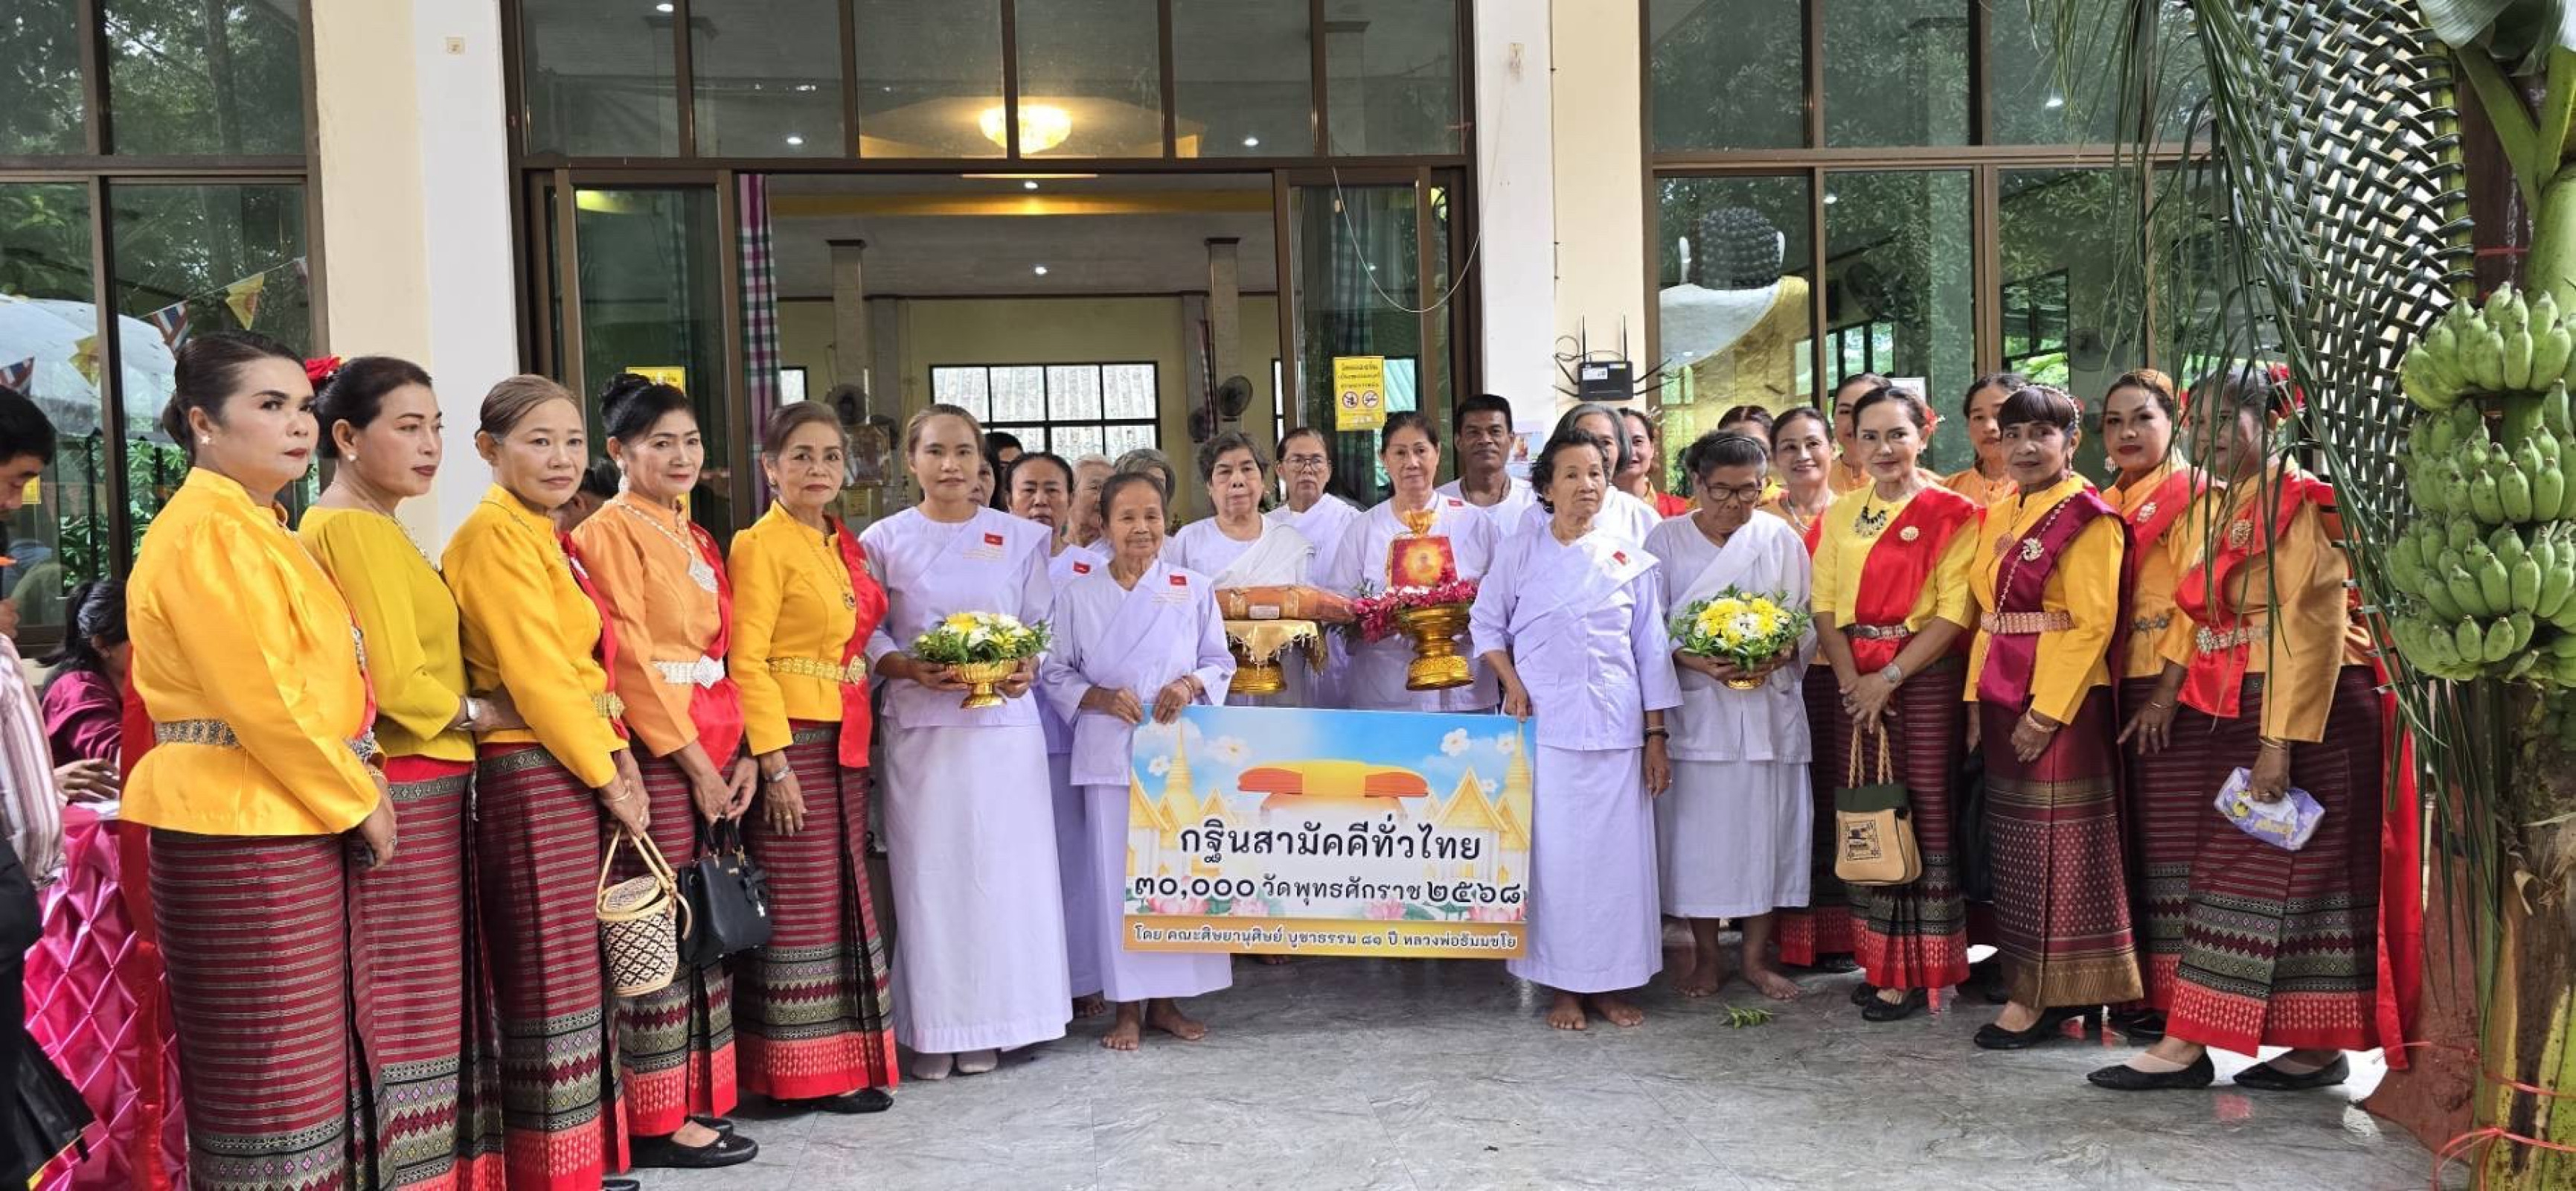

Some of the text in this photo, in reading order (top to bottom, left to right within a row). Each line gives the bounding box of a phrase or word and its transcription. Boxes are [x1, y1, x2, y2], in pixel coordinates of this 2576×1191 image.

[1180, 814, 1481, 863] กฐินสามัคคีทั่วไทย
[1134, 876, 1256, 900] ๓๐,๐๐๐
[1426, 881, 1522, 904] ๒๕๖๘
[1135, 925, 1517, 948] โดย คณะศิษยานุศิษย์ บูชาธรรม ๘๑ ปี หลวงพ่อธัมมชโย
